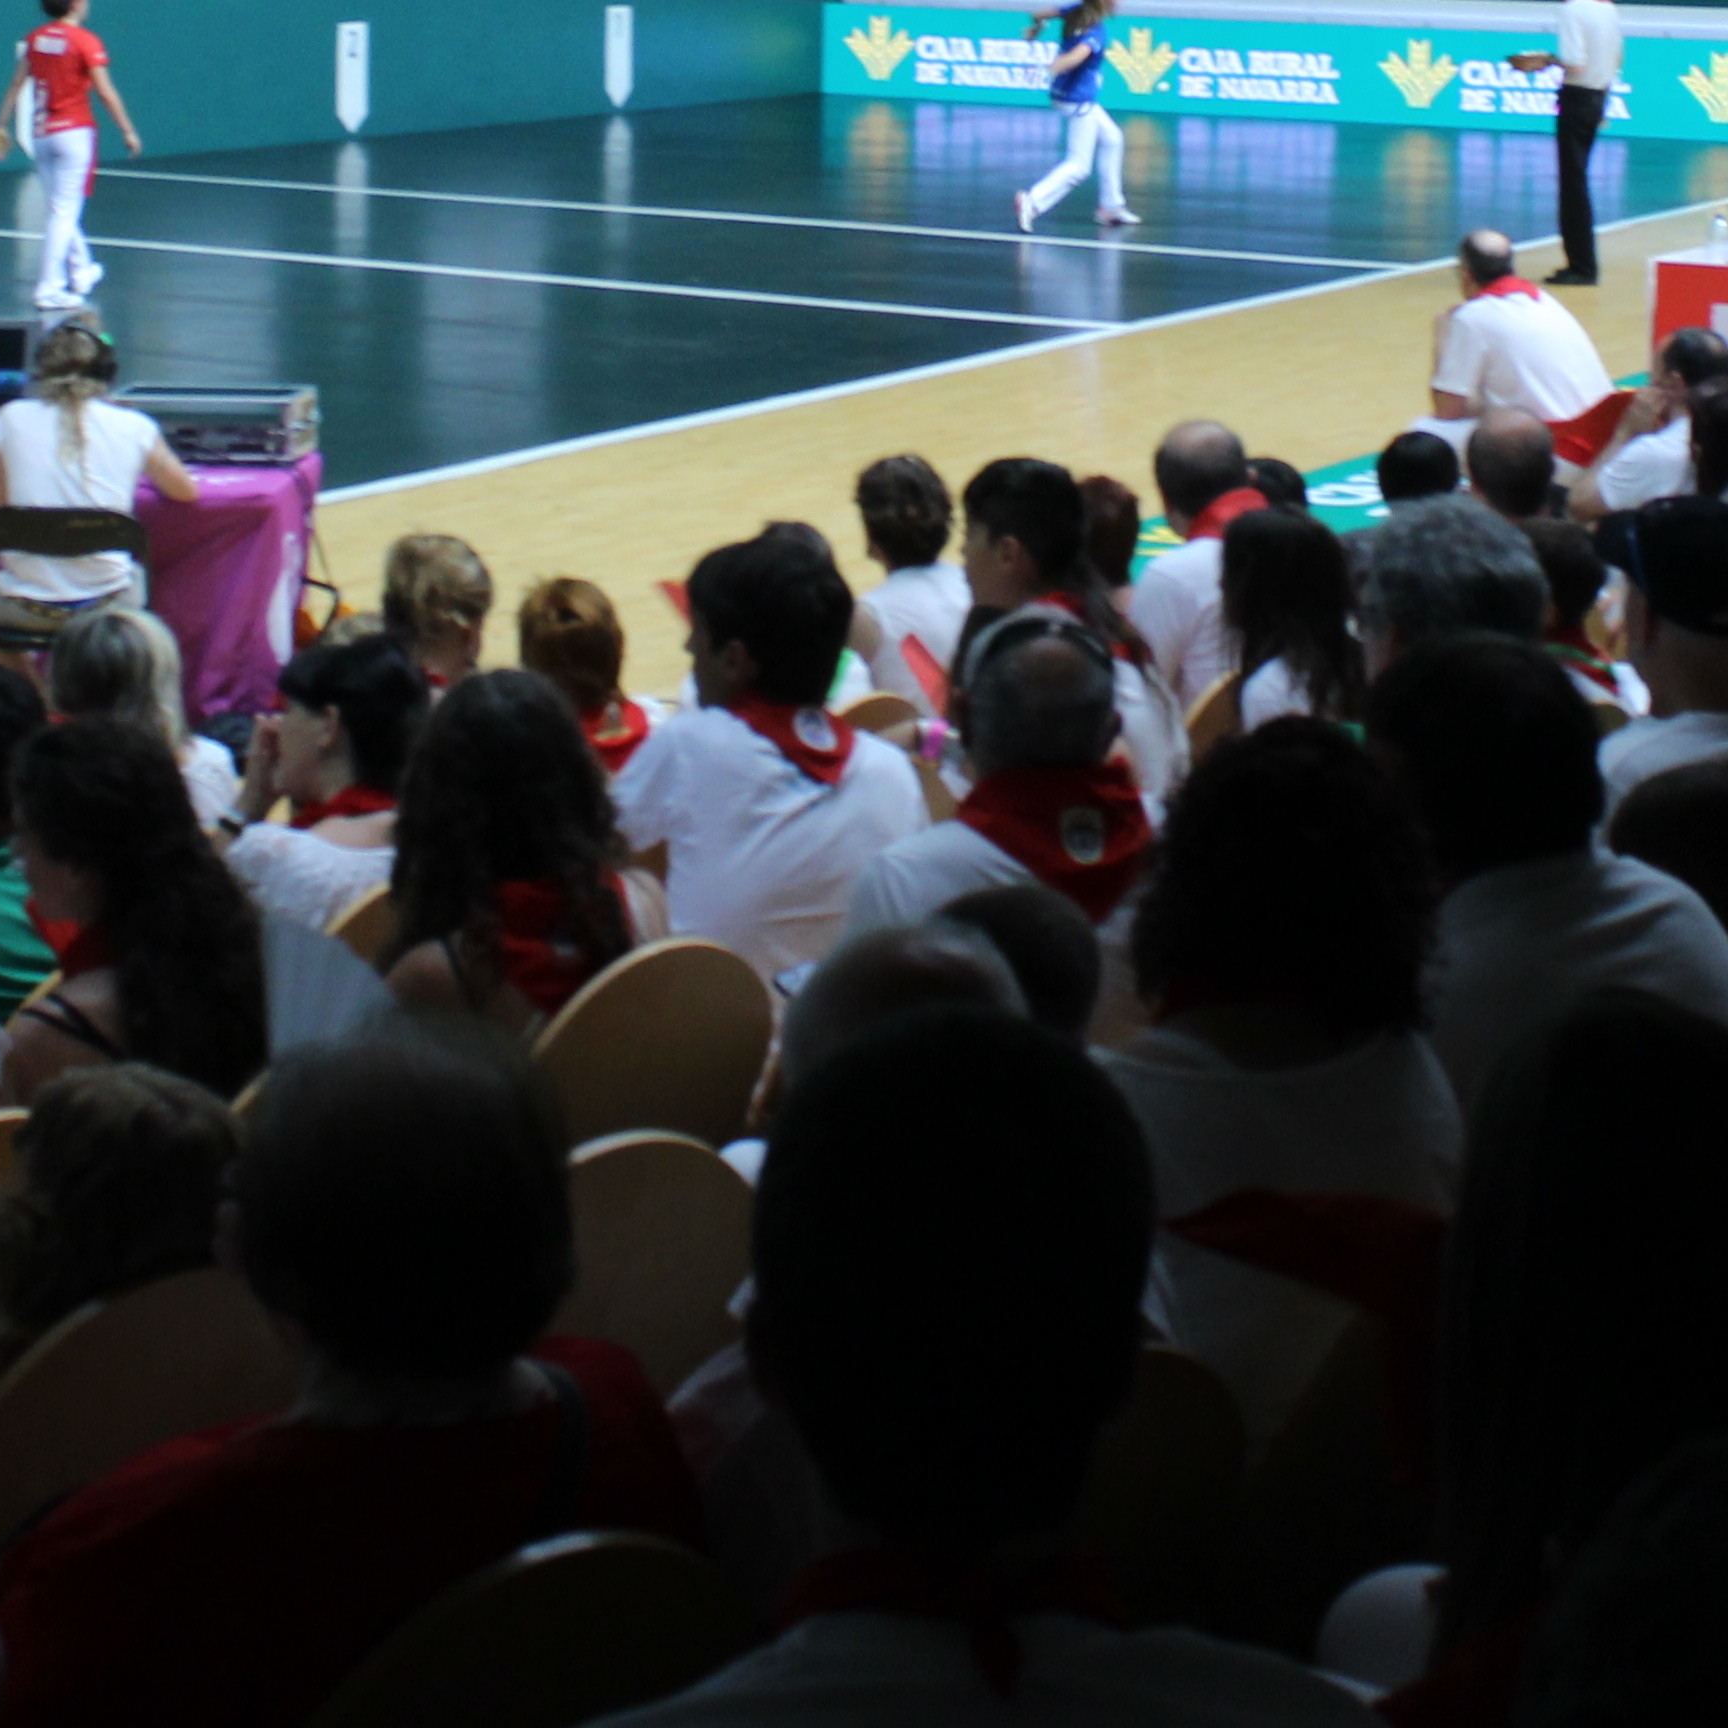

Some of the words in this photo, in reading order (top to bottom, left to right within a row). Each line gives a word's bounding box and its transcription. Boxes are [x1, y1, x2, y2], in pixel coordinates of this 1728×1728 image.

[914, 35, 978, 62] CAJA
[915, 61, 949, 85] DE
[1179, 46, 1246, 75] CAJA
[1247, 49, 1341, 80] RURAL
[1178, 74, 1214, 98] DE
[1216, 76, 1340, 104] NAVARRA
[1459, 87, 1497, 112] DE
